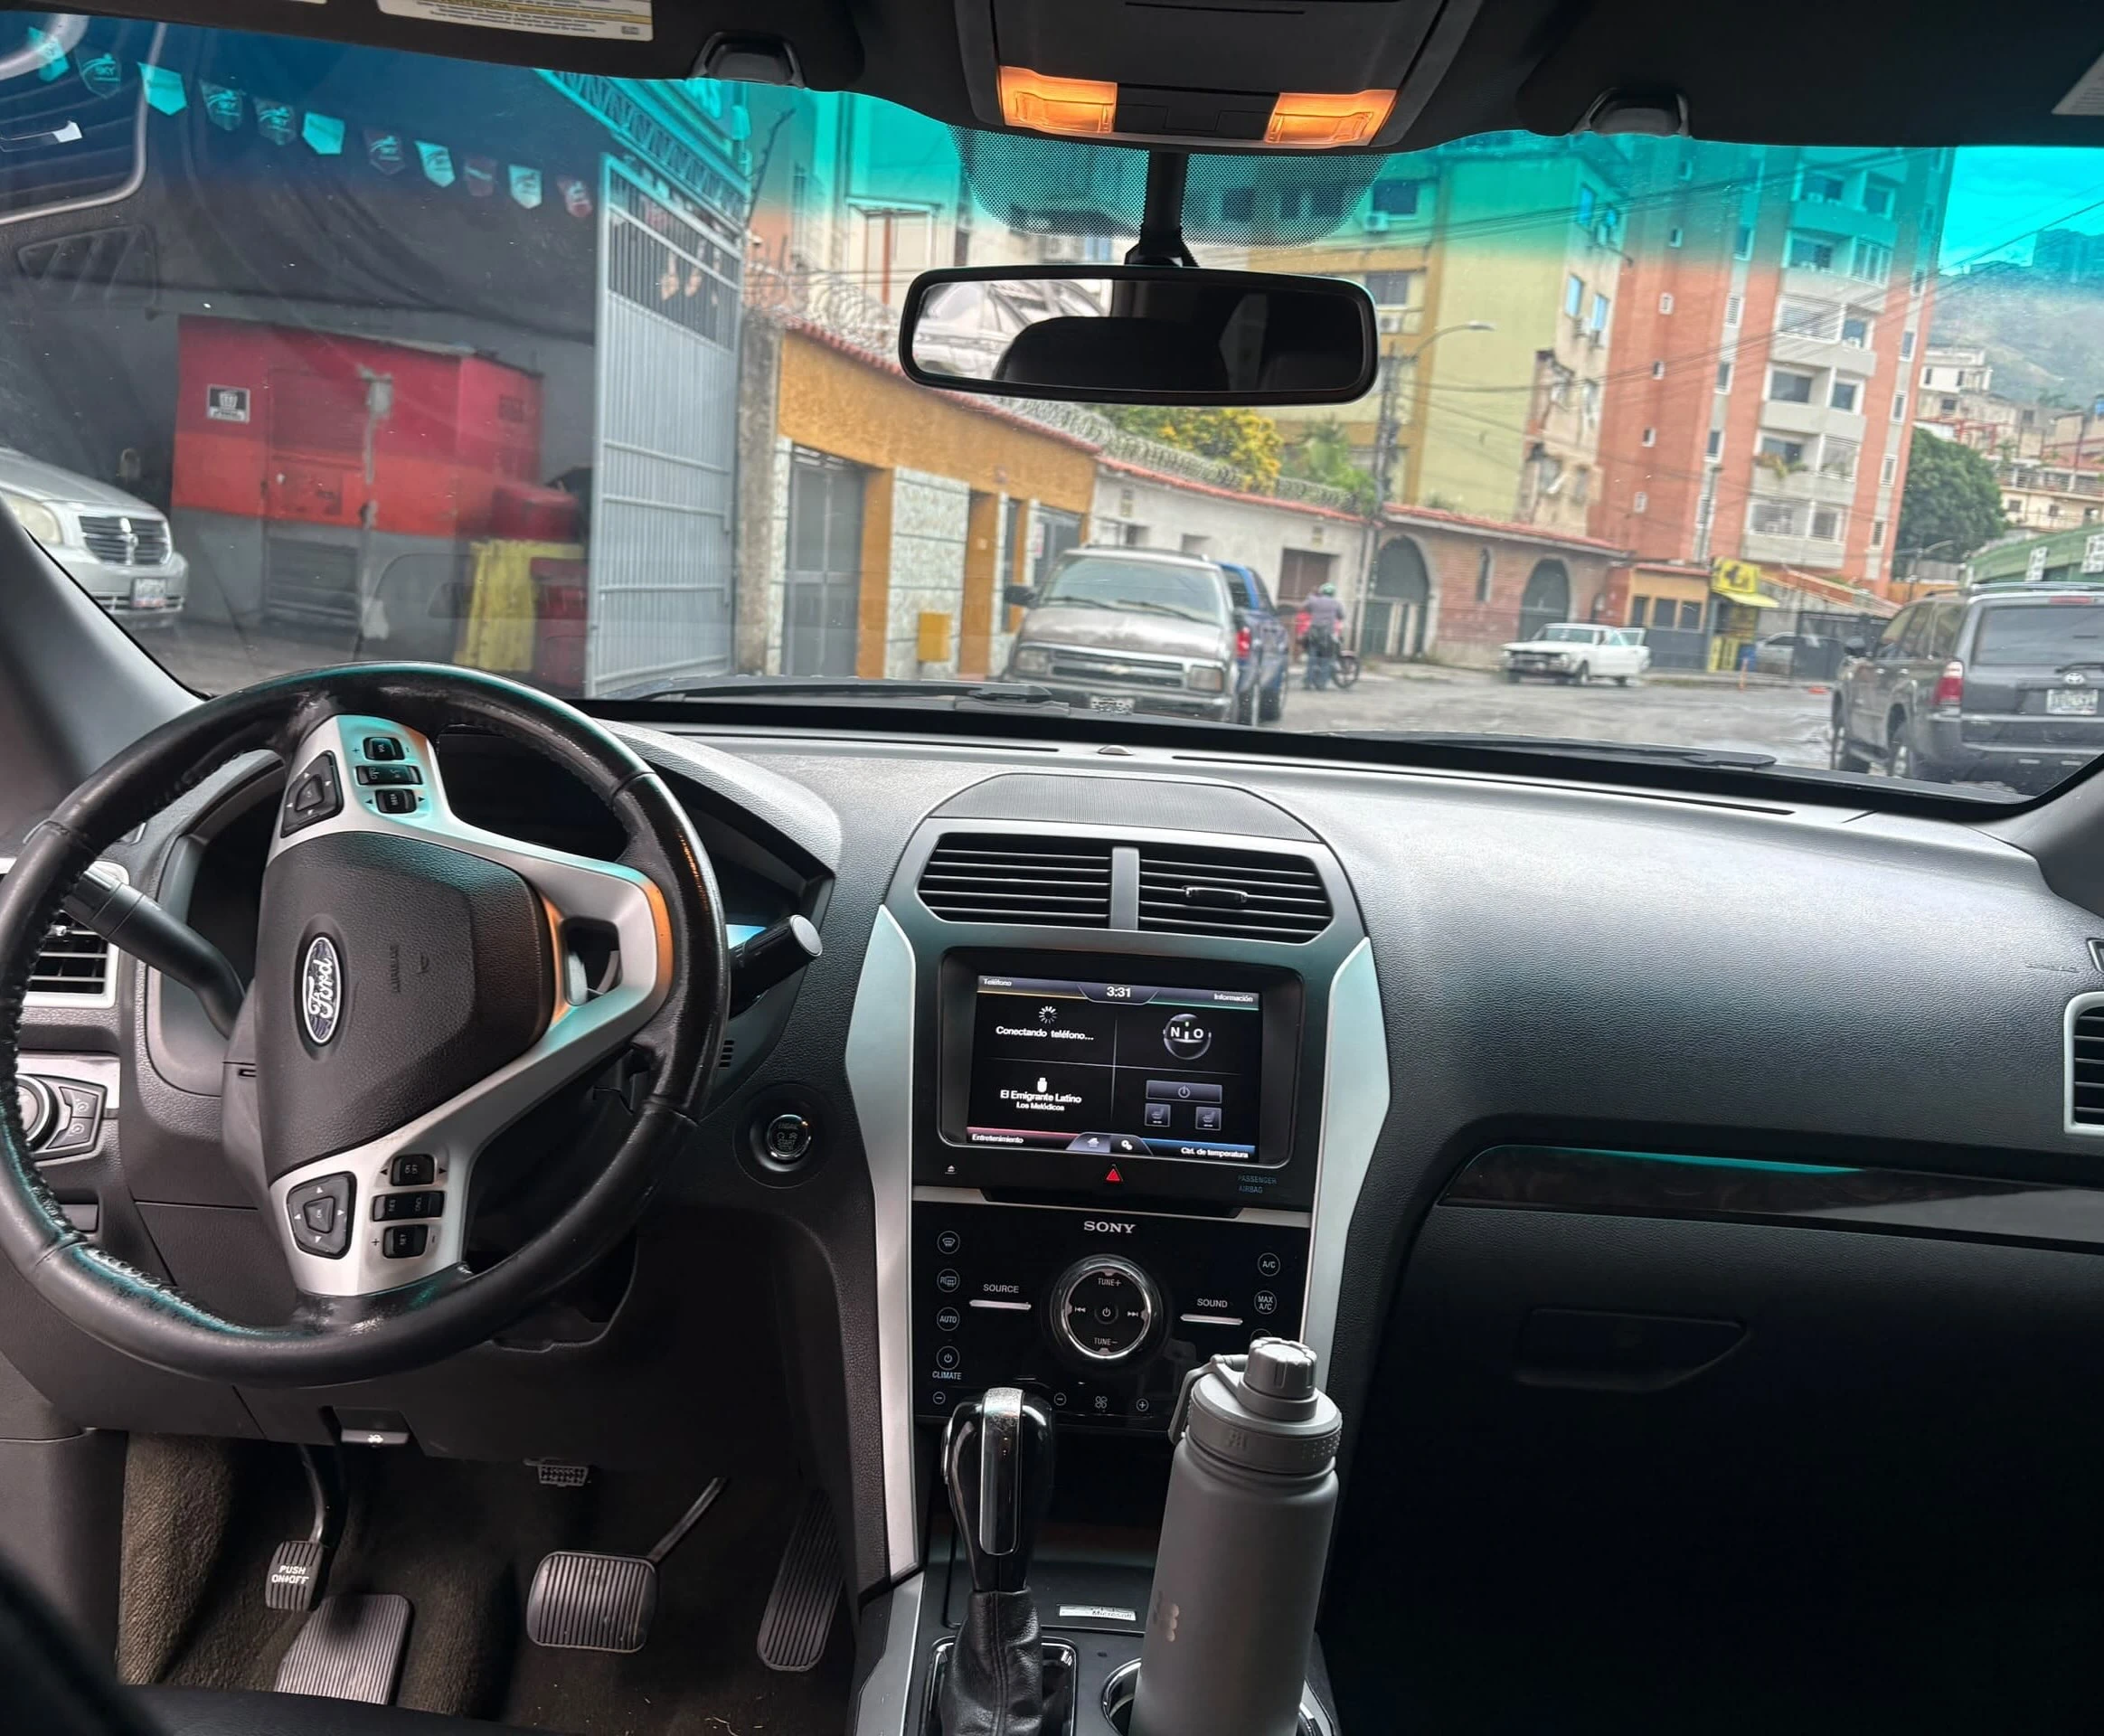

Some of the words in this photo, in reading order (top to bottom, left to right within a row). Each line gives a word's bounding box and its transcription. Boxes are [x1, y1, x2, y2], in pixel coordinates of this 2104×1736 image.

[983, 978, 1012, 986] Teléfono
[308, 958, 334, 1019] Ford
[1107, 986, 1131, 997] 3:31
[1213, 994, 1253, 1003] Información
[995, 1026, 1047, 1037] Conectando
[1000, 1090, 1009, 1099] El
[1011, 1090, 1053, 1101] Emigrante
[1055, 1093, 1082, 1103] Latino
[972, 1133, 1024, 1144] Entretenimiento
[1207, 1149, 1249, 1158] temperatura
[1238, 1175, 1277, 1184] PASSENGER
[1239, 1185, 1263, 1194] AIRBAG
[1084, 1221, 1136, 1233] SONY
[1262, 1260, 1276, 1269] A/C
[983, 1284, 1019, 1294] SOURCE
[1196, 1297, 1228, 1308] SOUND
[1258, 1296, 1273, 1304] MAX
[939, 1315, 958, 1324] AUTO
[932, 1371, 962, 1381] CLIMATE
[278, 1565, 307, 1575] PUSH
